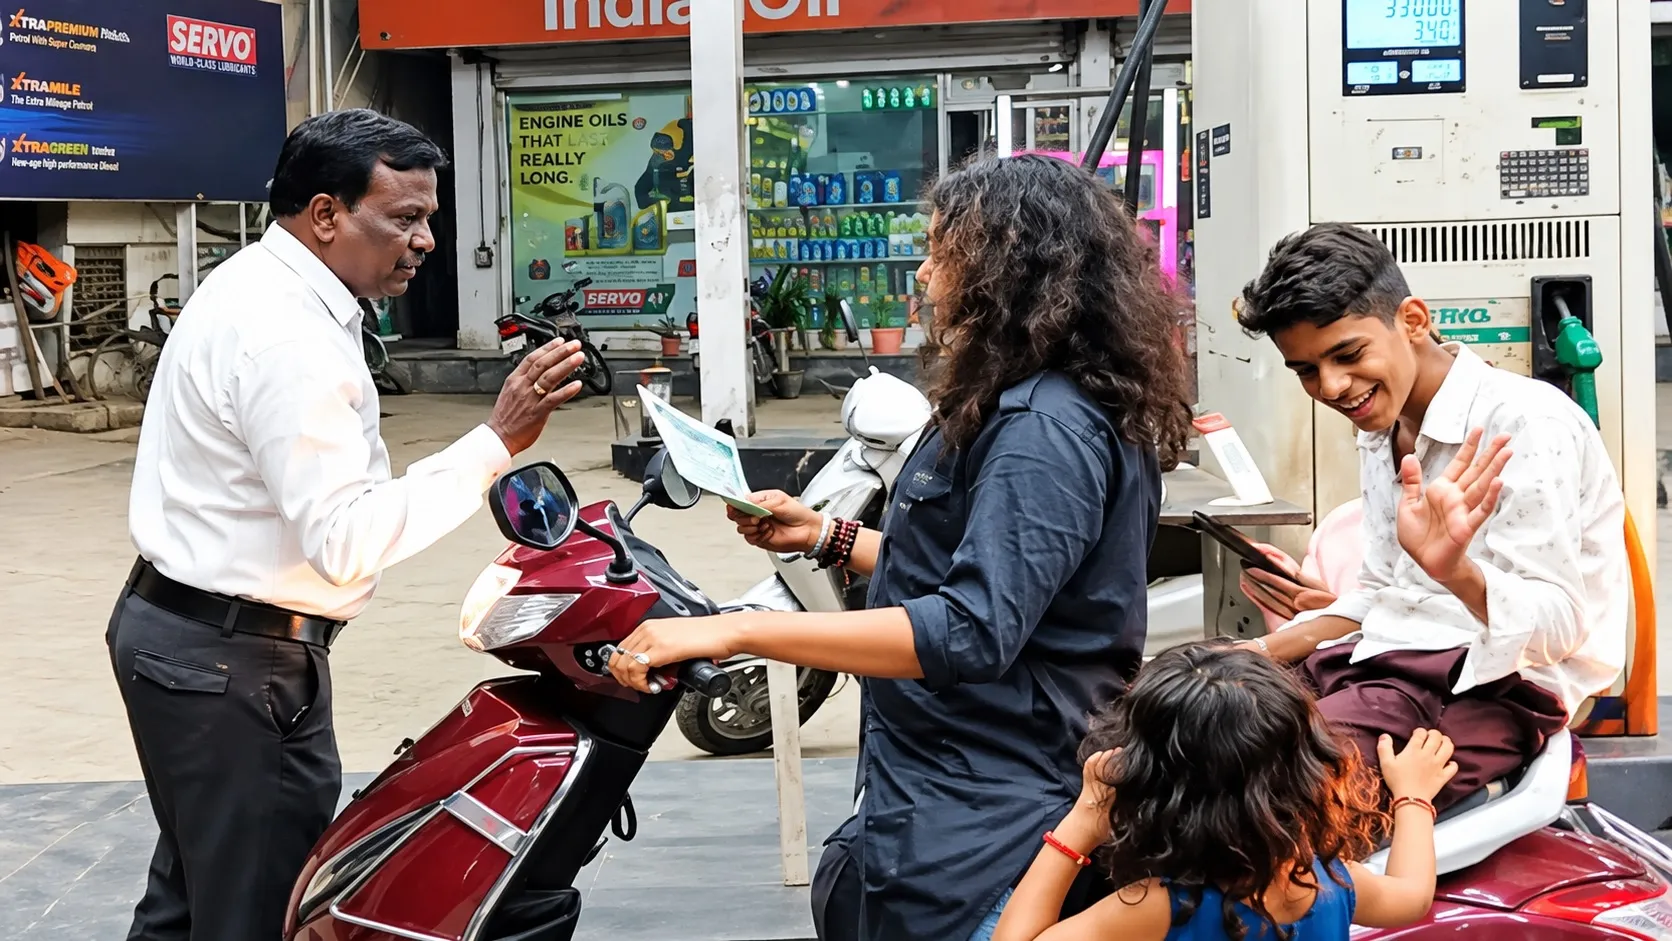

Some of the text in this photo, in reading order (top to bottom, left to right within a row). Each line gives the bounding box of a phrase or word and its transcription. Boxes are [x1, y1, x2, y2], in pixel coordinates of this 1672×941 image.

[170, 20, 252, 61] SERVO
[10, 71, 81, 96] XTRAMILE
[11, 94, 25, 105] The
[26, 96, 45, 107] Extra
[519, 113, 628, 130] ENGINE OILS
[11, 133, 90, 155] XTRAGREEN
[519, 132, 608, 148] THAT LAST
[520, 152, 586, 167] REALLY
[520, 171, 574, 185] LONG.
[587, 292, 643, 305] SERVO
